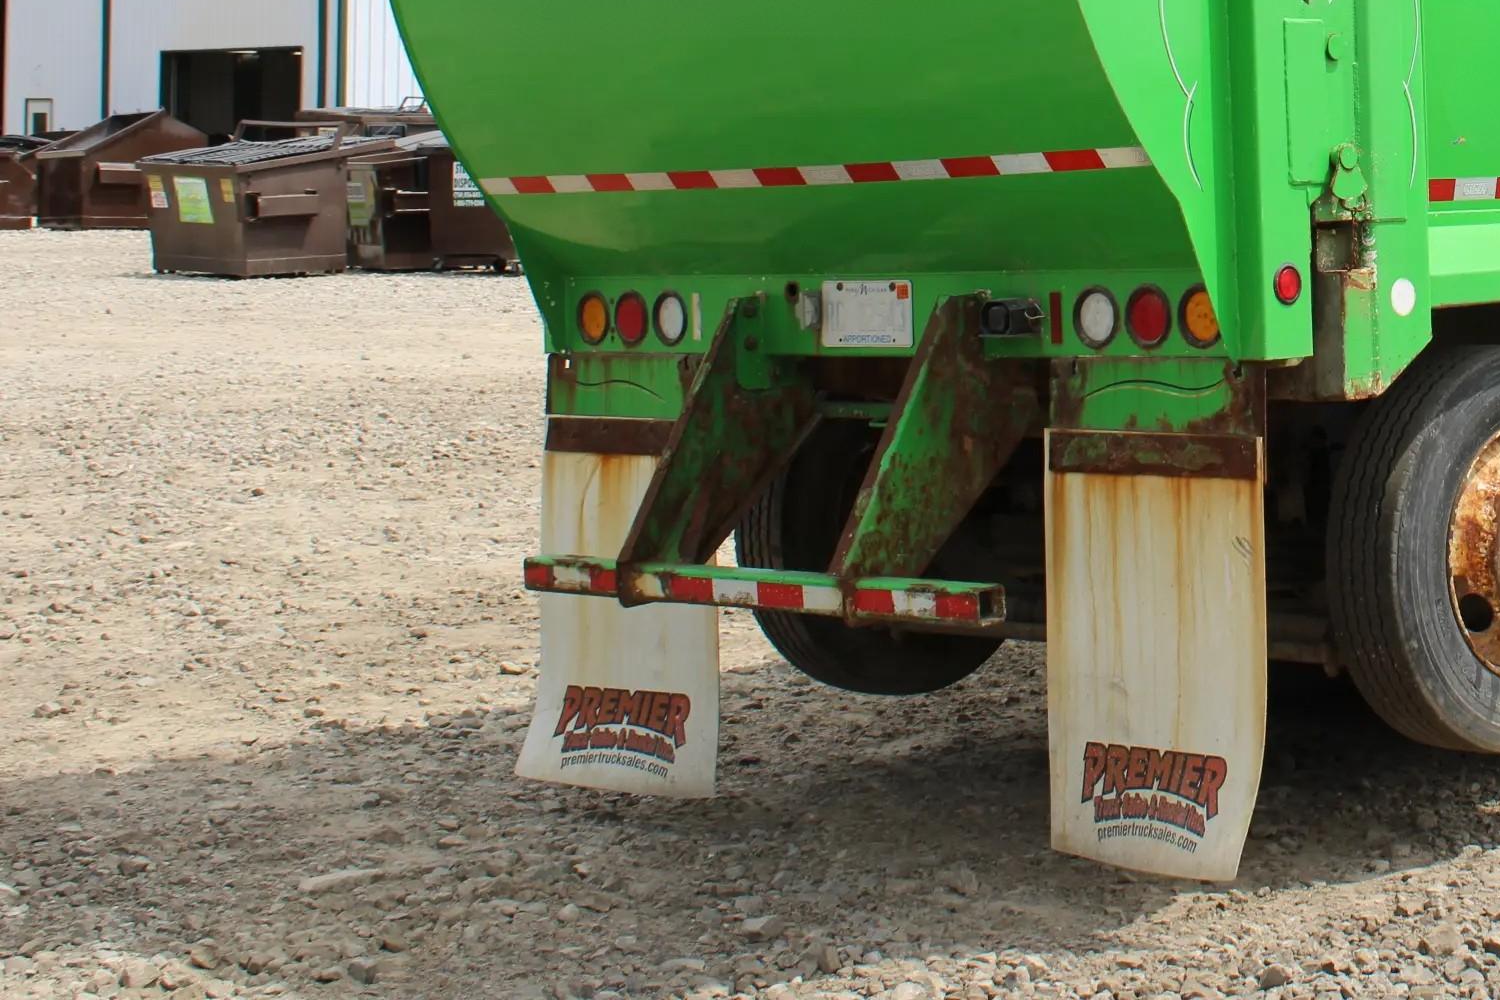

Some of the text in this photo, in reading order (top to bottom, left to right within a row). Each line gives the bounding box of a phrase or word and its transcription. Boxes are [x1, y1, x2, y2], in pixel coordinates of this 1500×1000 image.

[842, 334, 892, 345] APPORTIONED
[552, 685, 691, 749] PREMIER
[560, 751, 669, 778] premiertrucksales.com
[1081, 741, 1228, 821] PREMIER
[1098, 821, 1198, 854] premiertrucksales.com
